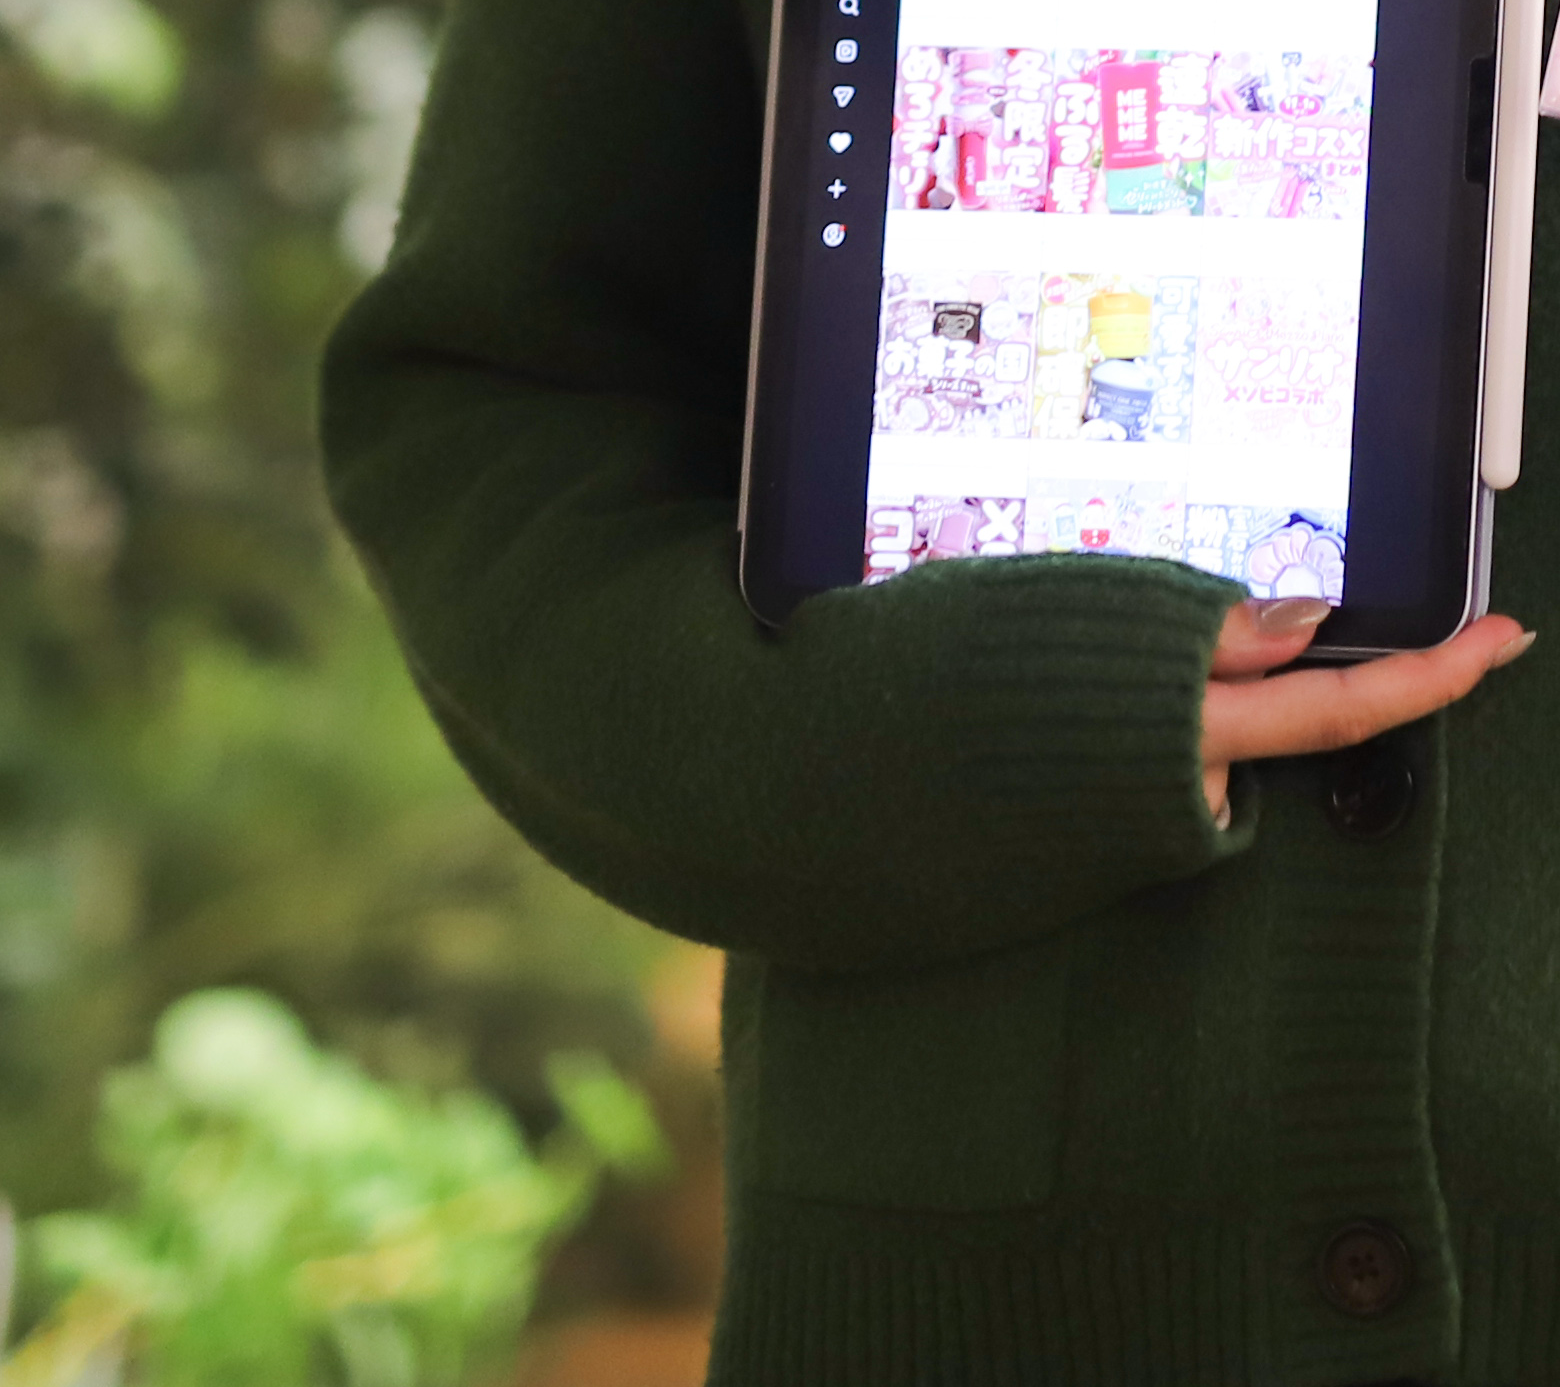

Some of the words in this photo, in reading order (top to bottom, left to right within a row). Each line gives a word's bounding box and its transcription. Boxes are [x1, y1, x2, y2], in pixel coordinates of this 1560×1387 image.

[1003, 50, 1053, 188] 冬限定
[1117, 88, 1147, 107] ME
[1117, 106, 1147, 125] ME
[1118, 123, 1148, 143] ME
[1213, 114, 1366, 158] 新作コスメ
[1324, 162, 1362, 177] まとめ
[883, 335, 1031, 382] お菓子の国
[1034, 305, 1089, 439] 即確保
[1153, 277, 1198, 440] 可愛すぎて
[1204, 338, 1345, 388] サンリオ
